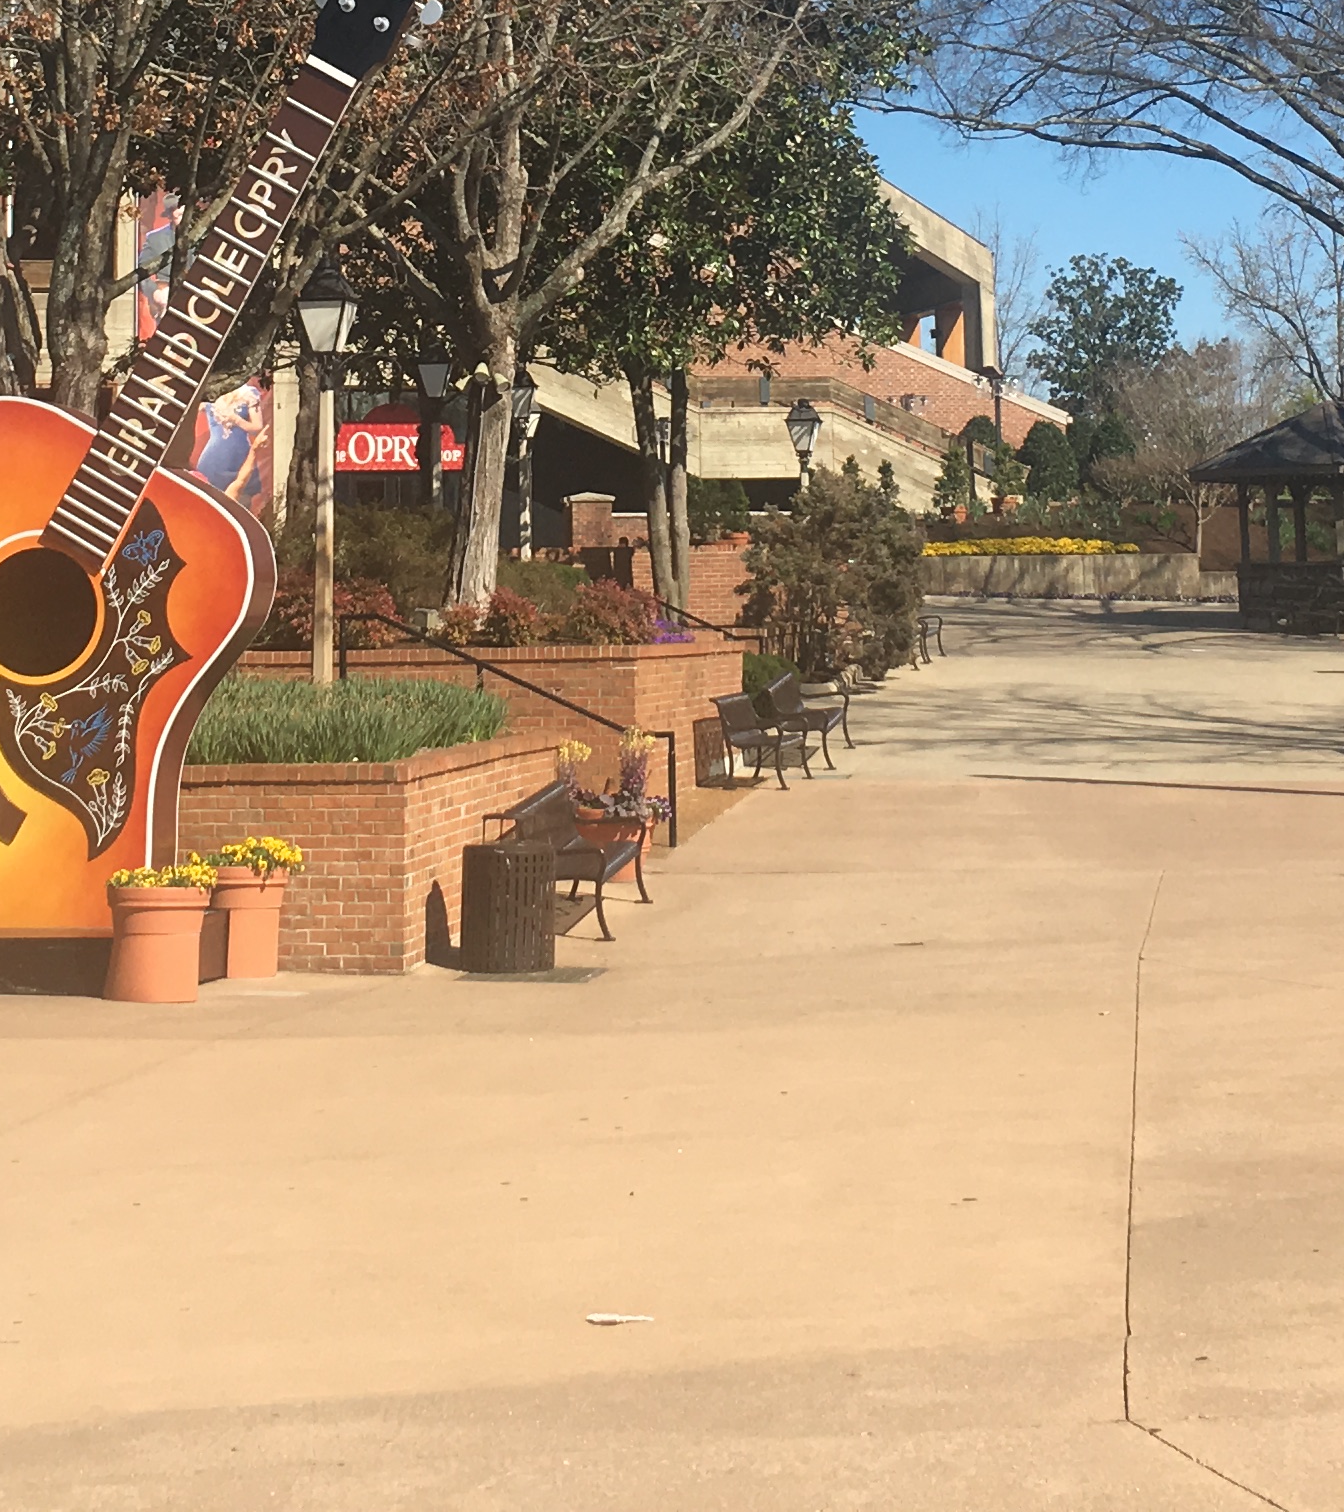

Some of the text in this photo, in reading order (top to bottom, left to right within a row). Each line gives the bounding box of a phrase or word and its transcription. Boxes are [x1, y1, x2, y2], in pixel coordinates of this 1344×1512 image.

[108, 128, 298, 477] GRAND OLE OPRY
